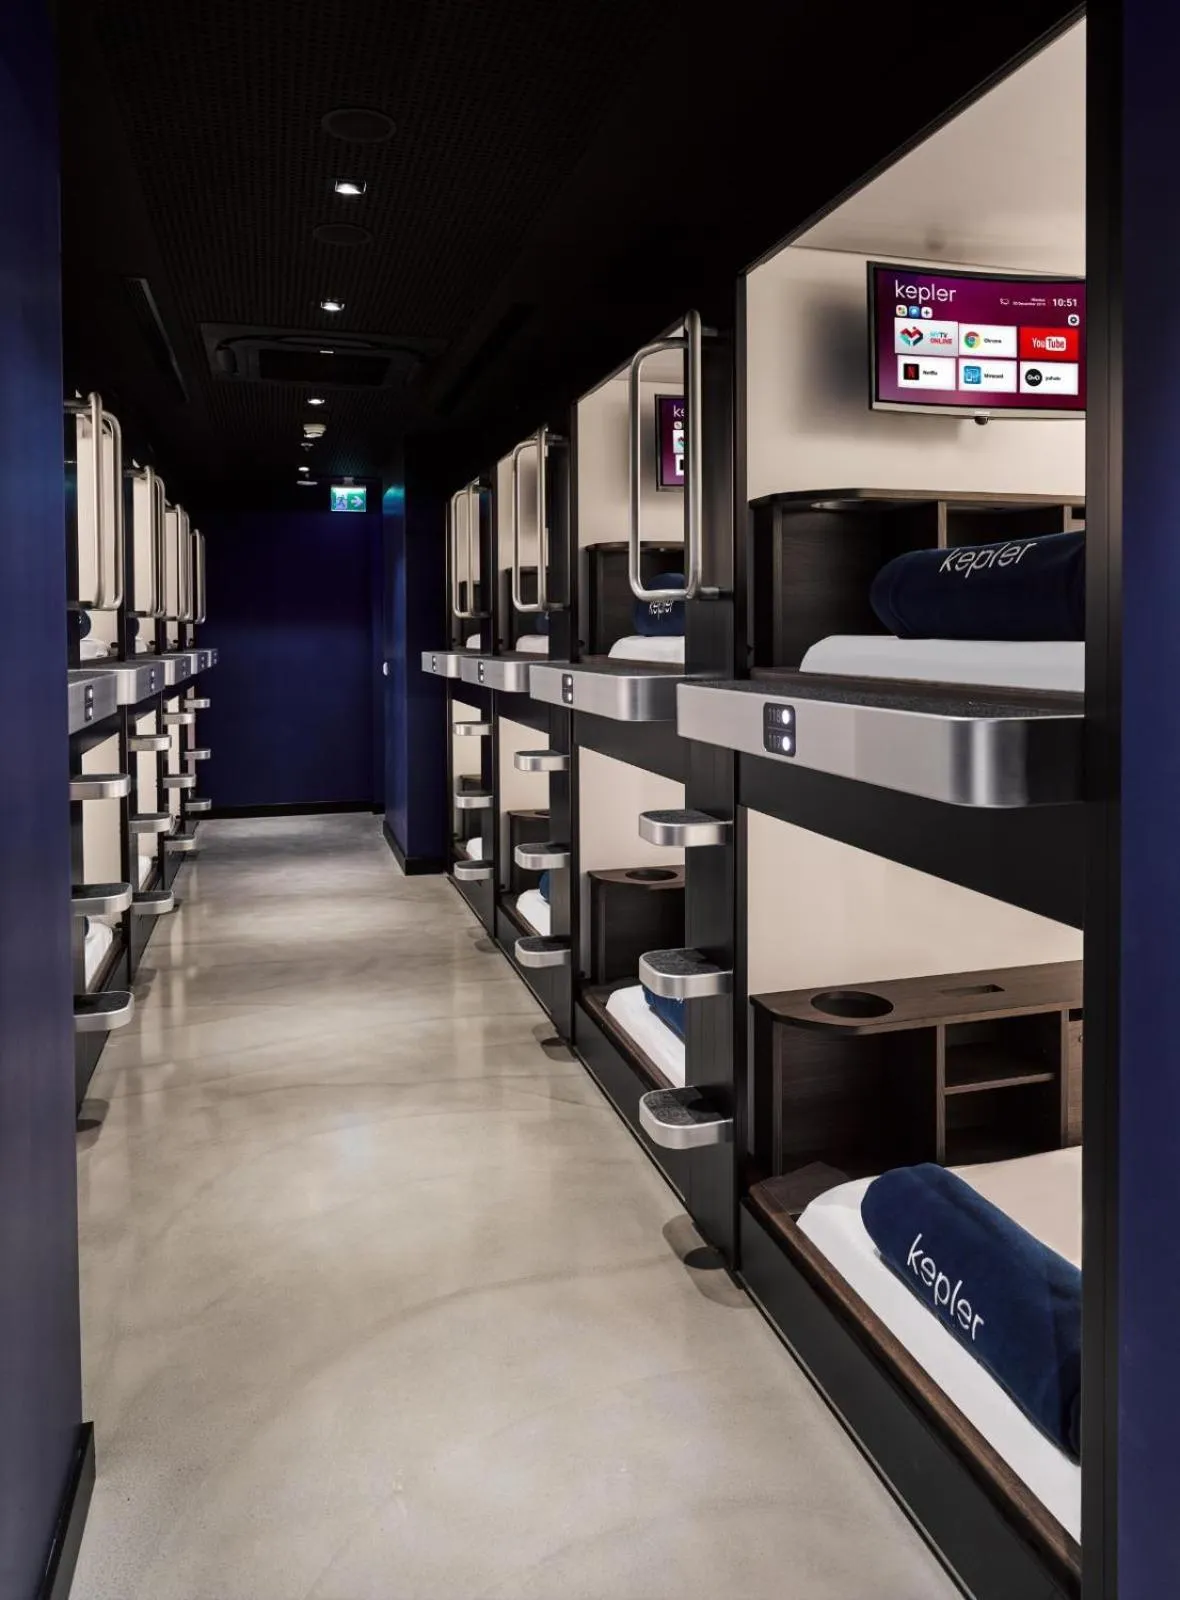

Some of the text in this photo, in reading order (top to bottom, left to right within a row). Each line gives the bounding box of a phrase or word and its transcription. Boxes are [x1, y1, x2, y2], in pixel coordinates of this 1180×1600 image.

[895, 280, 956, 303] kepler
[1052, 298, 1077, 307] 10:51
[1032, 337, 1066, 351] YouTube
[939, 542, 1037, 579] kepler
[907, 1233, 985, 1340] kepler
